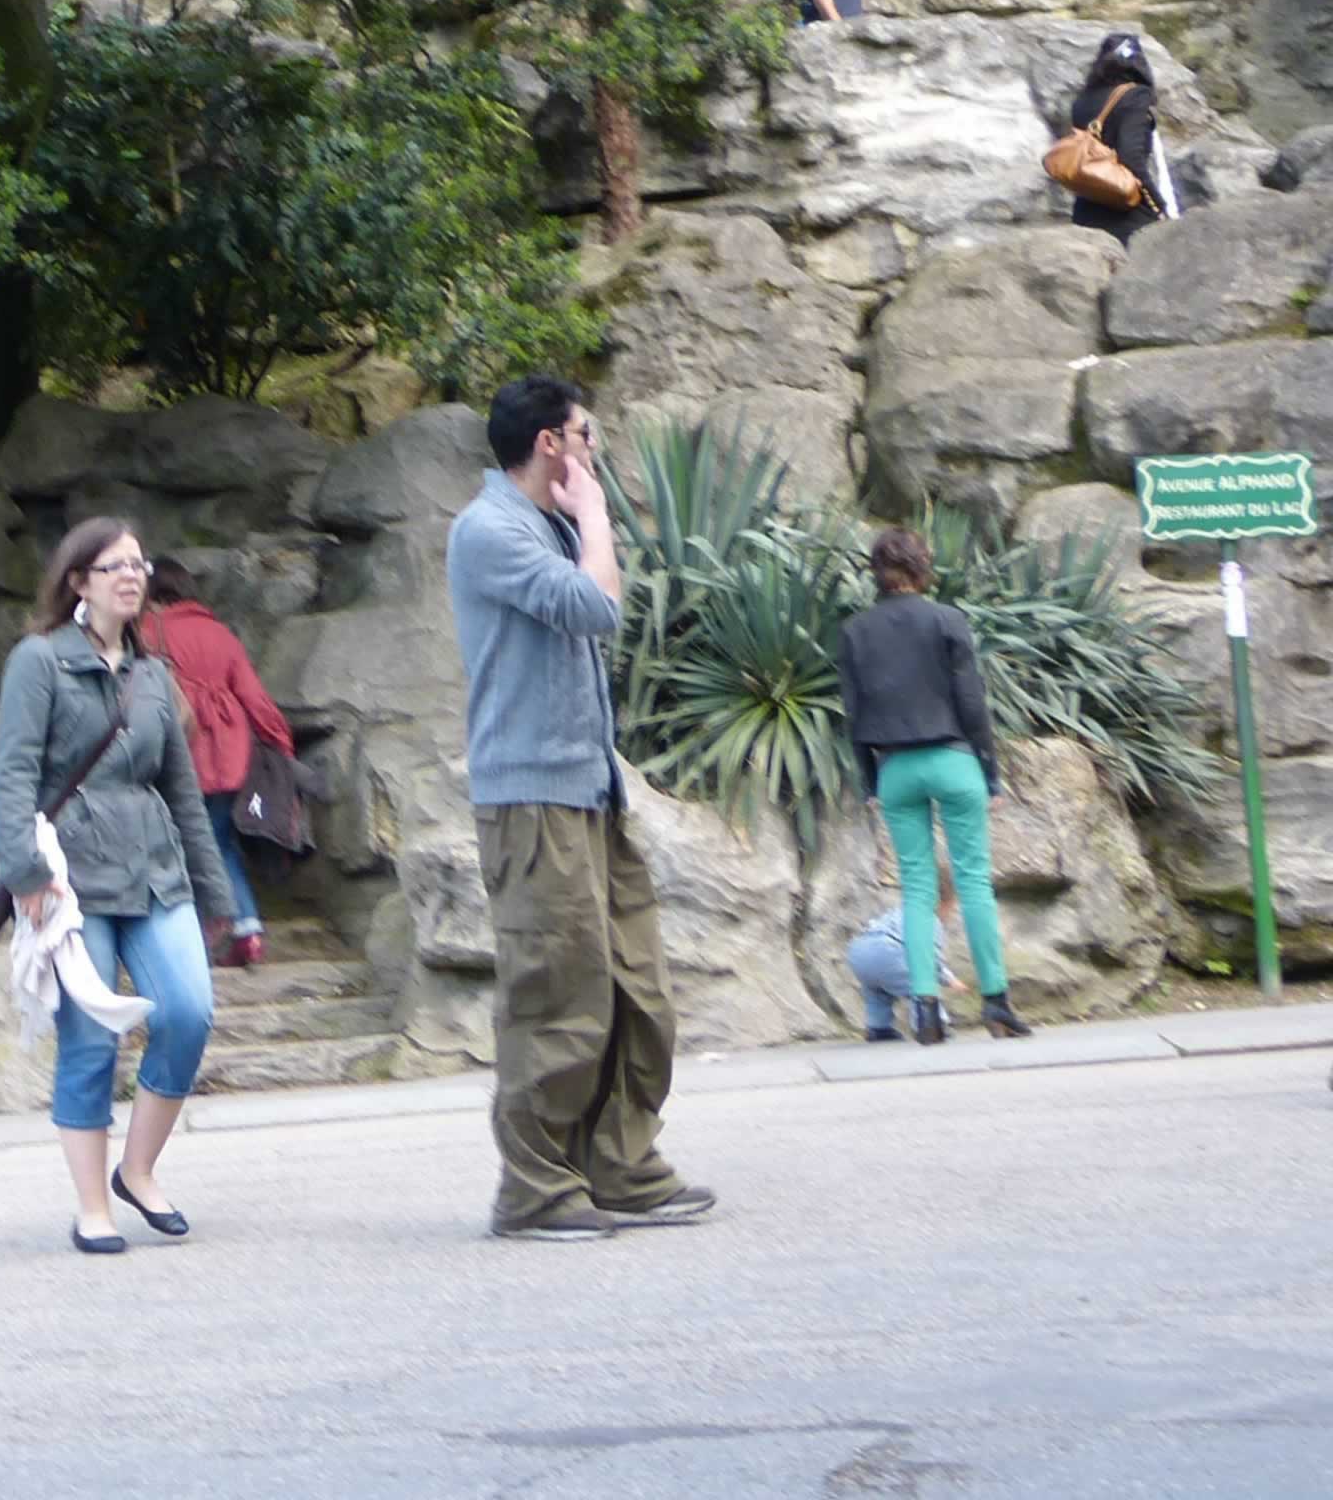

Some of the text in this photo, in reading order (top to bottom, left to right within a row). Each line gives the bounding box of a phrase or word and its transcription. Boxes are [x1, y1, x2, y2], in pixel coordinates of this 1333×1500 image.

[1157, 476, 1217, 493] AVENUE
[1153, 503, 1246, 520] RESTAURANT
[1247, 503, 1271, 517] DU
